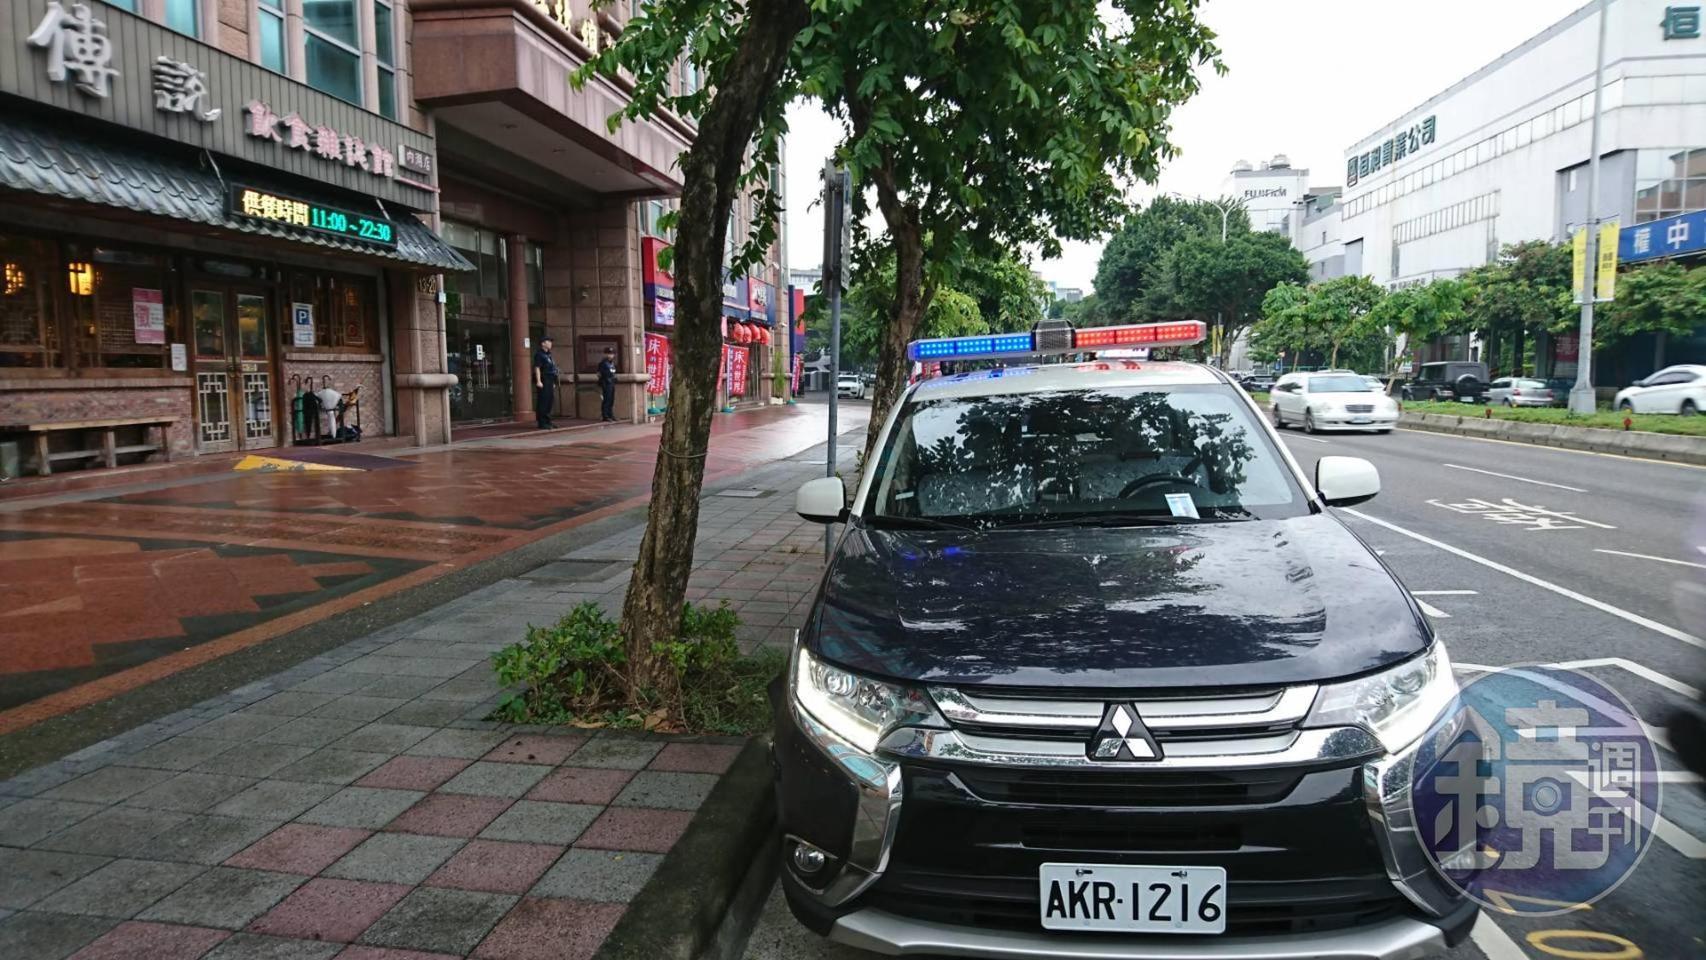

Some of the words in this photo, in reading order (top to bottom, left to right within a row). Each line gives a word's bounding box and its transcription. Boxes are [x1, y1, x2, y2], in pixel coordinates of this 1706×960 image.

[1244, 188, 1287, 198] FUJIFILM
[312, 208, 347, 232] 11:00
[359, 219, 391, 242] 22:30
[1046, 880, 1222, 923] AKR-1216
